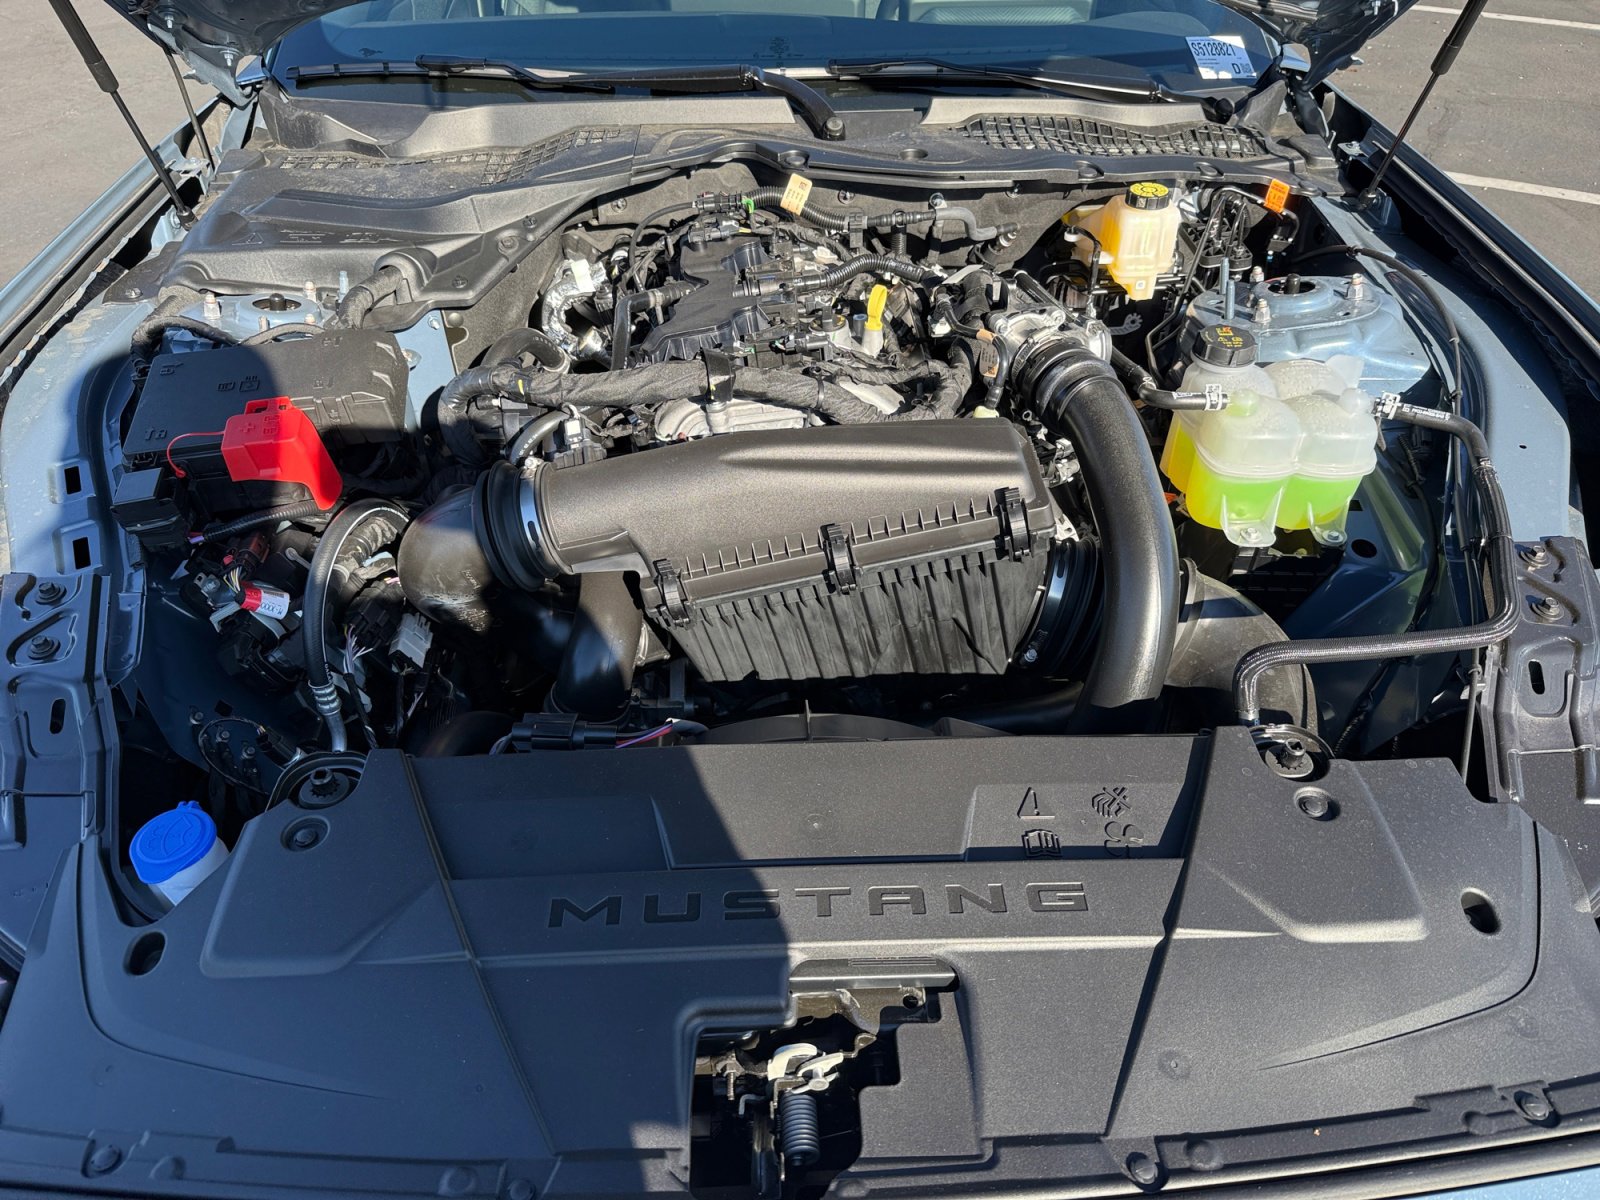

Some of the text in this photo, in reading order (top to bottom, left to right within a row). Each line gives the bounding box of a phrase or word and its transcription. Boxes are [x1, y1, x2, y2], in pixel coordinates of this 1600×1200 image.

[1191, 42, 1236, 56] S5128821
[1231, 63, 1241, 74] D
[548, 882, 1088, 928] MUSTANG
